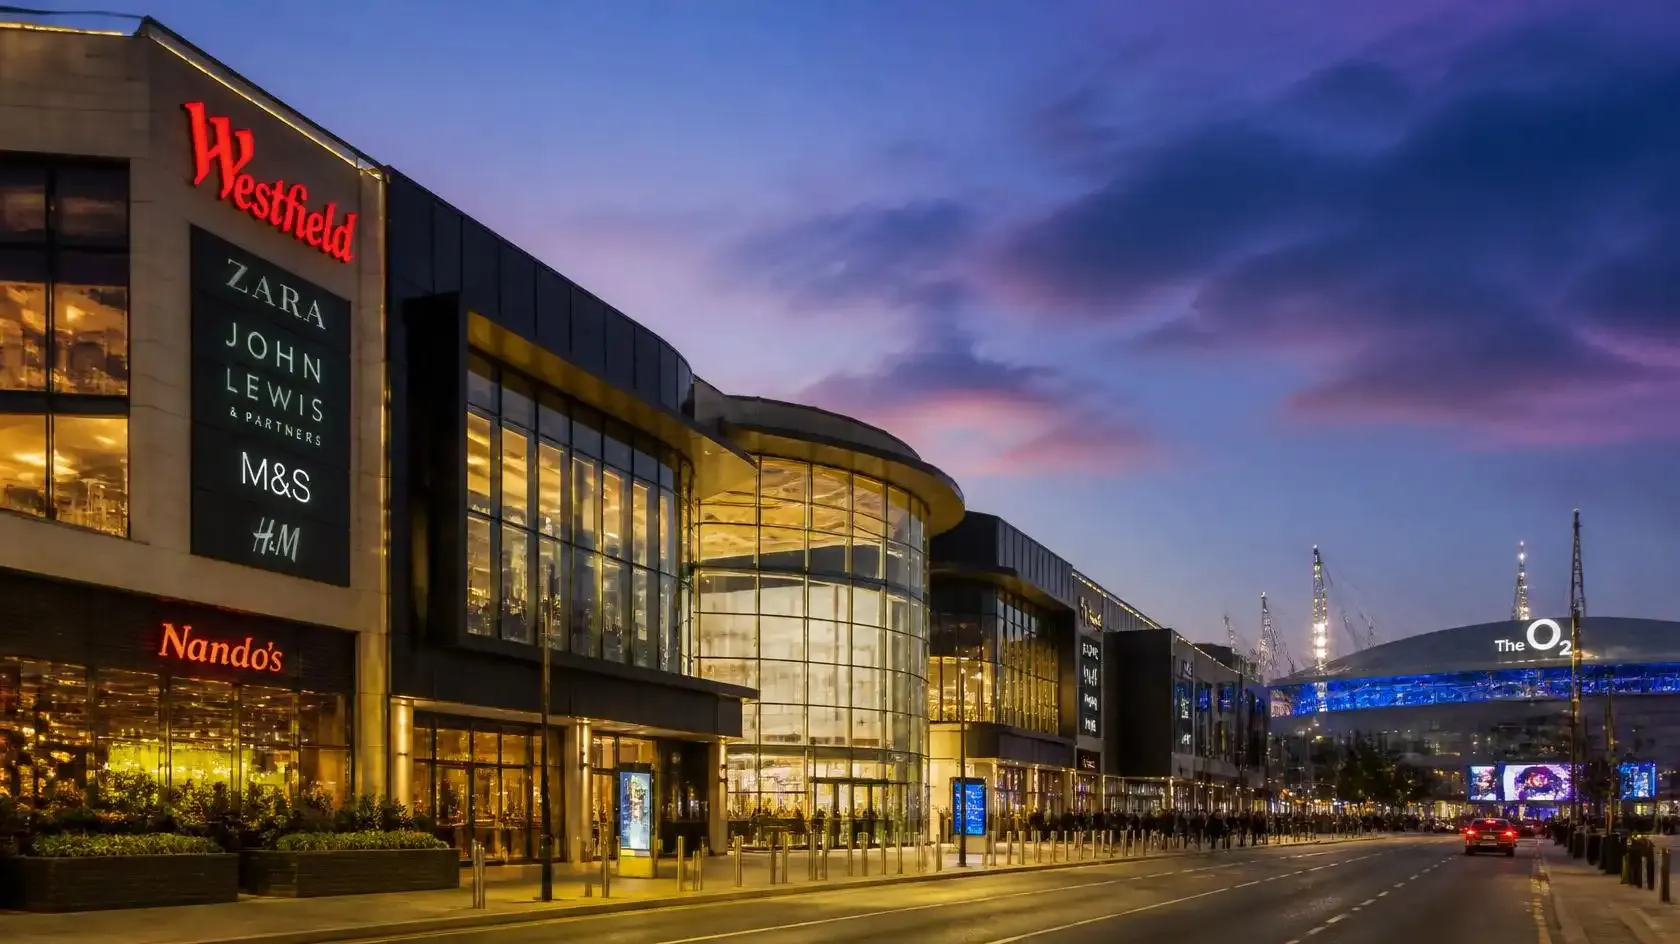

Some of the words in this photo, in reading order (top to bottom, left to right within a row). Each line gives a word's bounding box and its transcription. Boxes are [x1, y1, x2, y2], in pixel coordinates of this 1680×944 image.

[184, 101, 357, 263] Westfield
[225, 258, 326, 330] ZARA
[226, 322, 321, 384] JOHN
[227, 368, 323, 422] LEWIS
[229, 406, 238, 418] &
[245, 411, 321, 446] PARTNERS
[241, 451, 311, 503] M&S
[252, 517, 300, 562] H&M
[158, 623, 283, 672] Nando's
[1494, 639, 1526, 652] The
